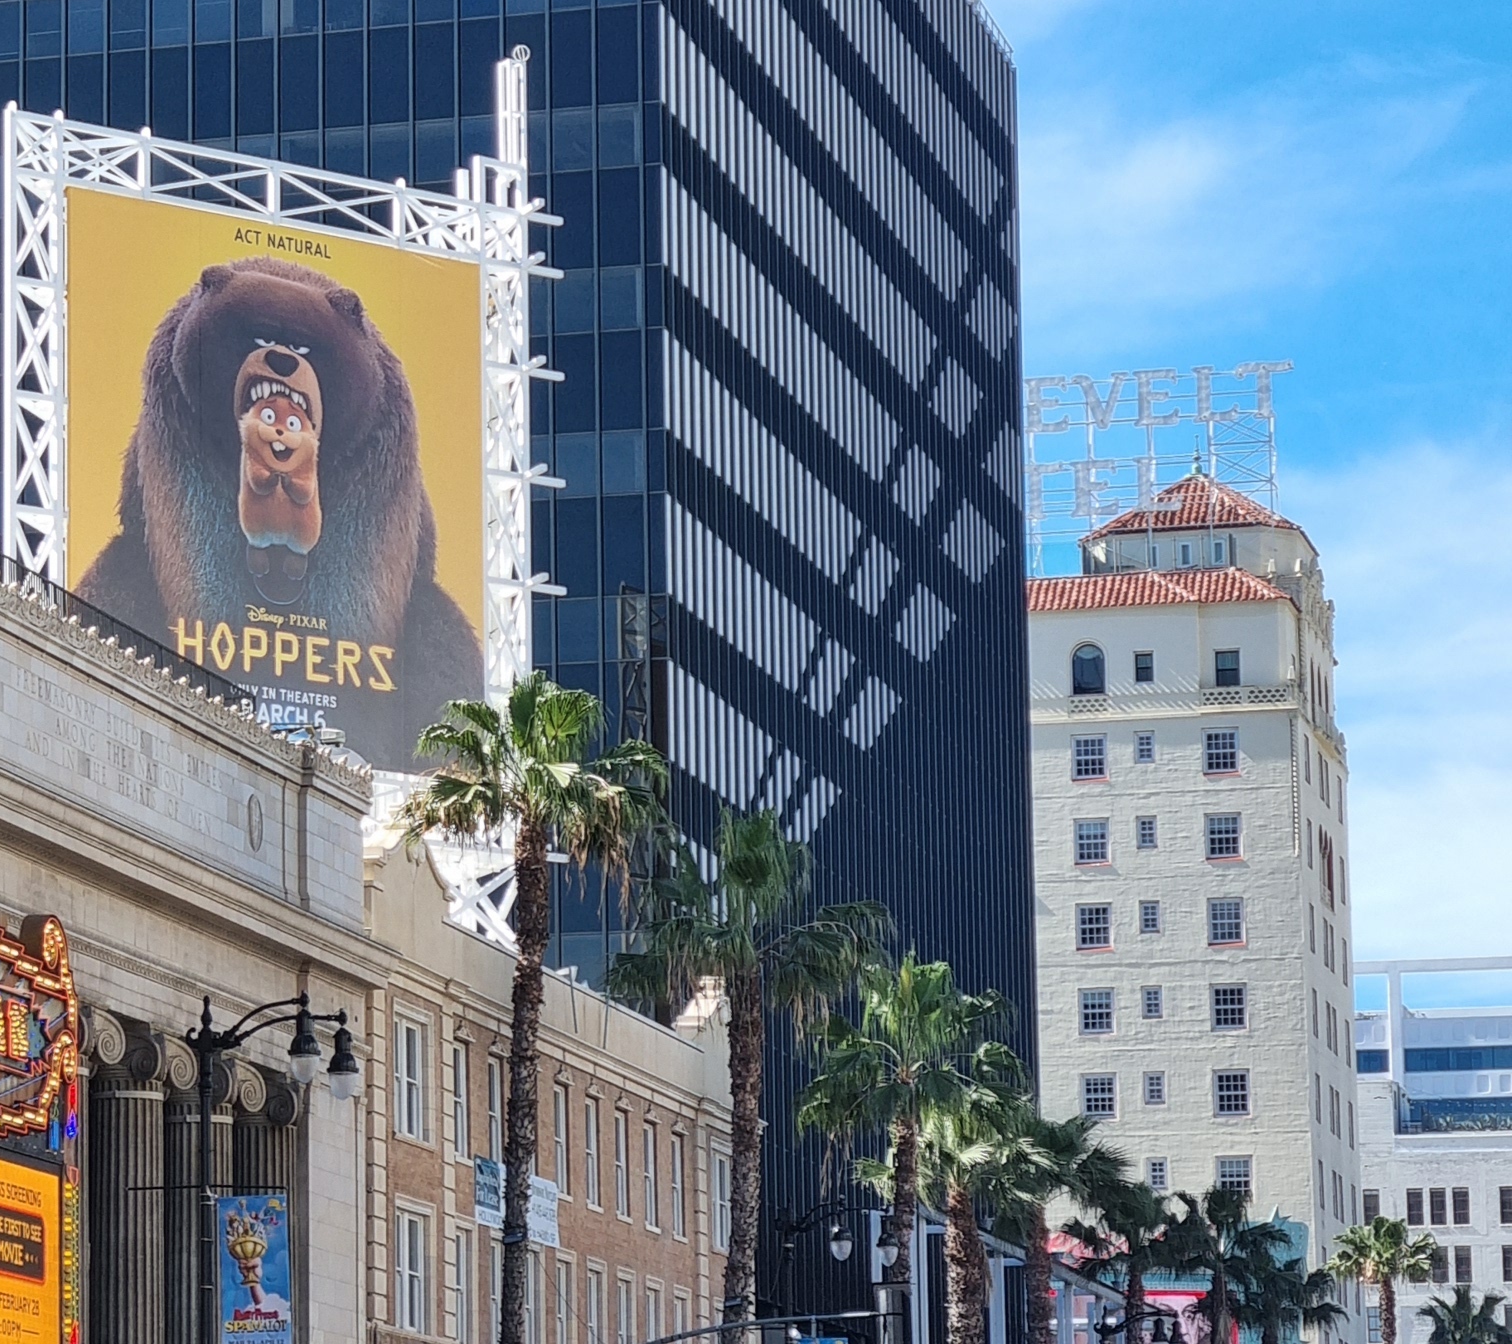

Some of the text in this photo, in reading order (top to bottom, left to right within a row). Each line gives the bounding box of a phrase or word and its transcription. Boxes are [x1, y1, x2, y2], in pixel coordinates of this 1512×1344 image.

[234, 227, 332, 260] ACT NATURAL
[245, 605, 327, 630] Disney PIXAR
[172, 617, 396, 692] HOPPERS
[15, 667, 96, 725] FREEMASONRY
[262, 687, 276, 700] IN
[280, 688, 337, 708] THEATERS
[255, 702, 326, 729] ARCH 6
[55, 717, 96, 753] AMONG
[106, 740, 128, 769] THE
[25, 730, 50, 757] AND
[86, 758, 107, 786] THE
[6, 1182, 42, 1208] SCREENING
[4, 1217, 23, 1237] FIRST
[23, 1222, 30, 1239] TO
[30, 1225, 42, 1243] SEE
[0, 1293, 32, 1315] FEBRUARY
[32, 1299, 40, 1316] 28
[224, 1319, 287, 1334] SPAMALOT
